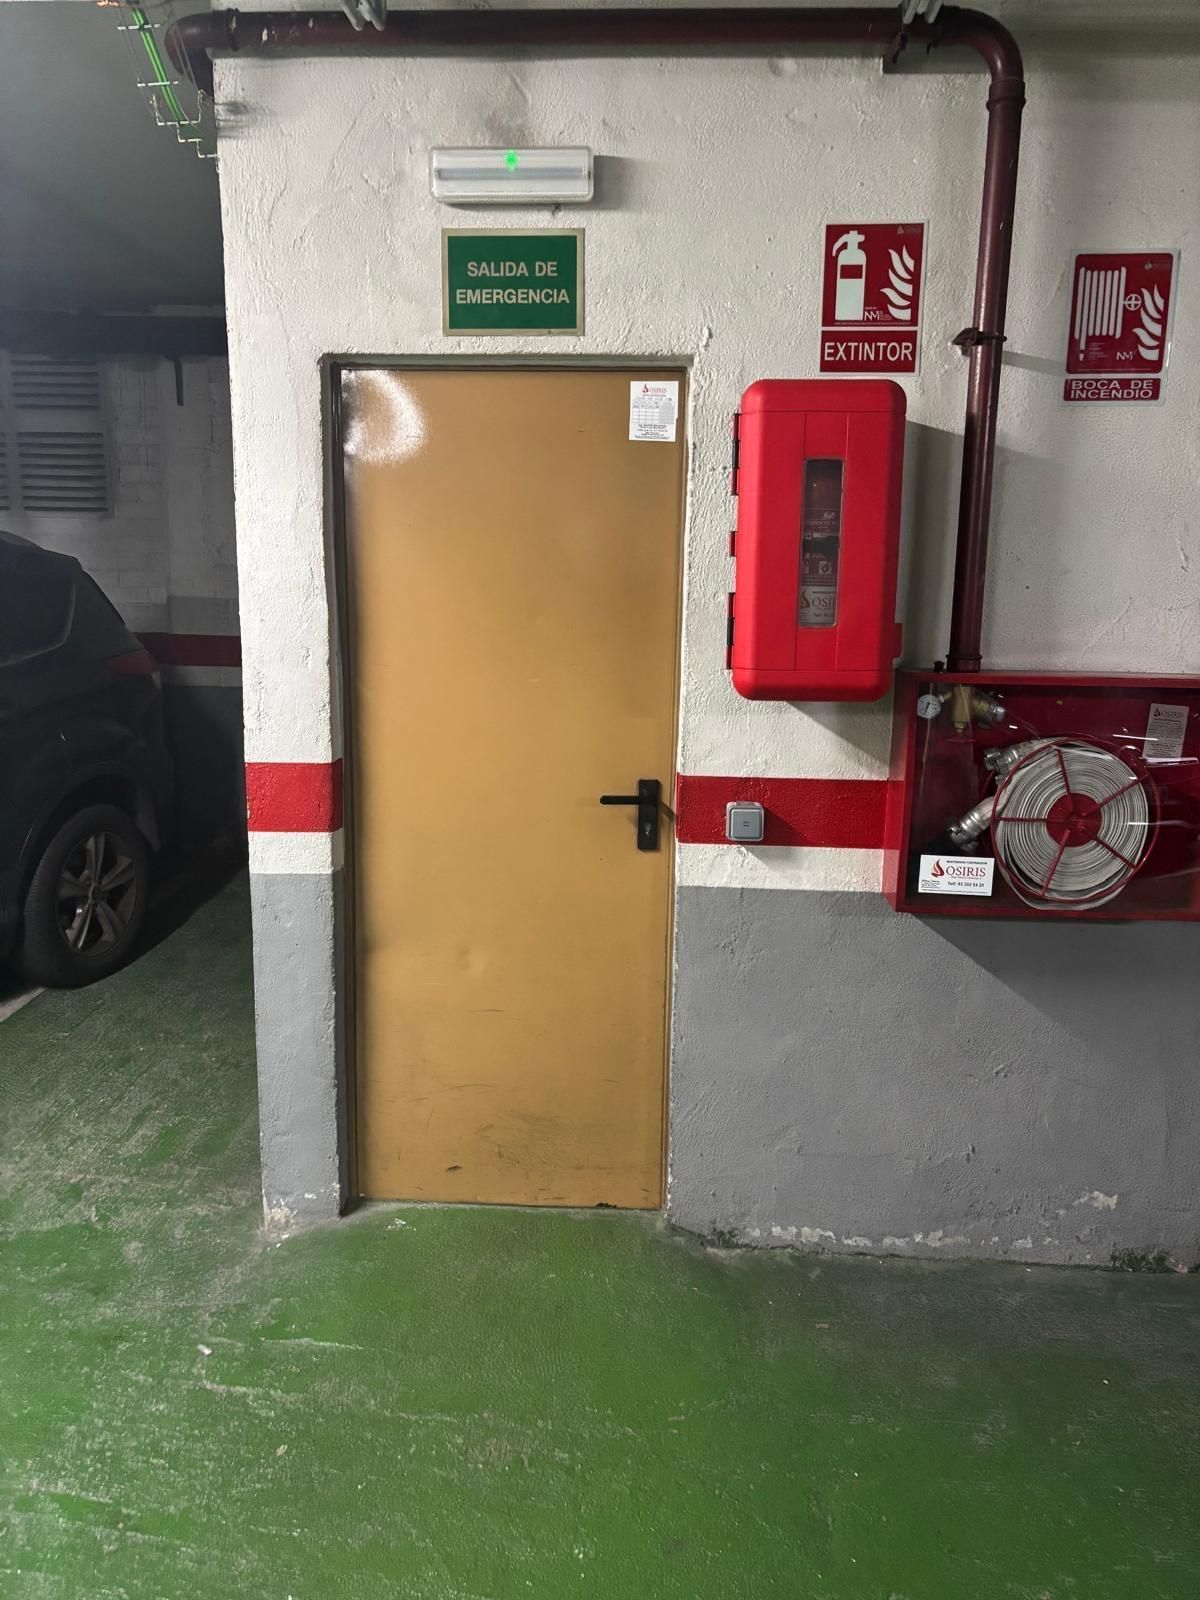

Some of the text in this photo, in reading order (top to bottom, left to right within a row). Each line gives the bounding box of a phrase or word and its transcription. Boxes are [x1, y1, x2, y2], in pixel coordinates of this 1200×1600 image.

[467, 261, 558, 277] SALIDA DE
[456, 288, 570, 304] EMERGENCIA
[824, 341, 913, 362] EXTINTOR
[1071, 380, 1154, 390] BOCA DE
[1070, 389, 1153, 399] INCENDIO
[945, 865, 986, 878] OSIRIS
